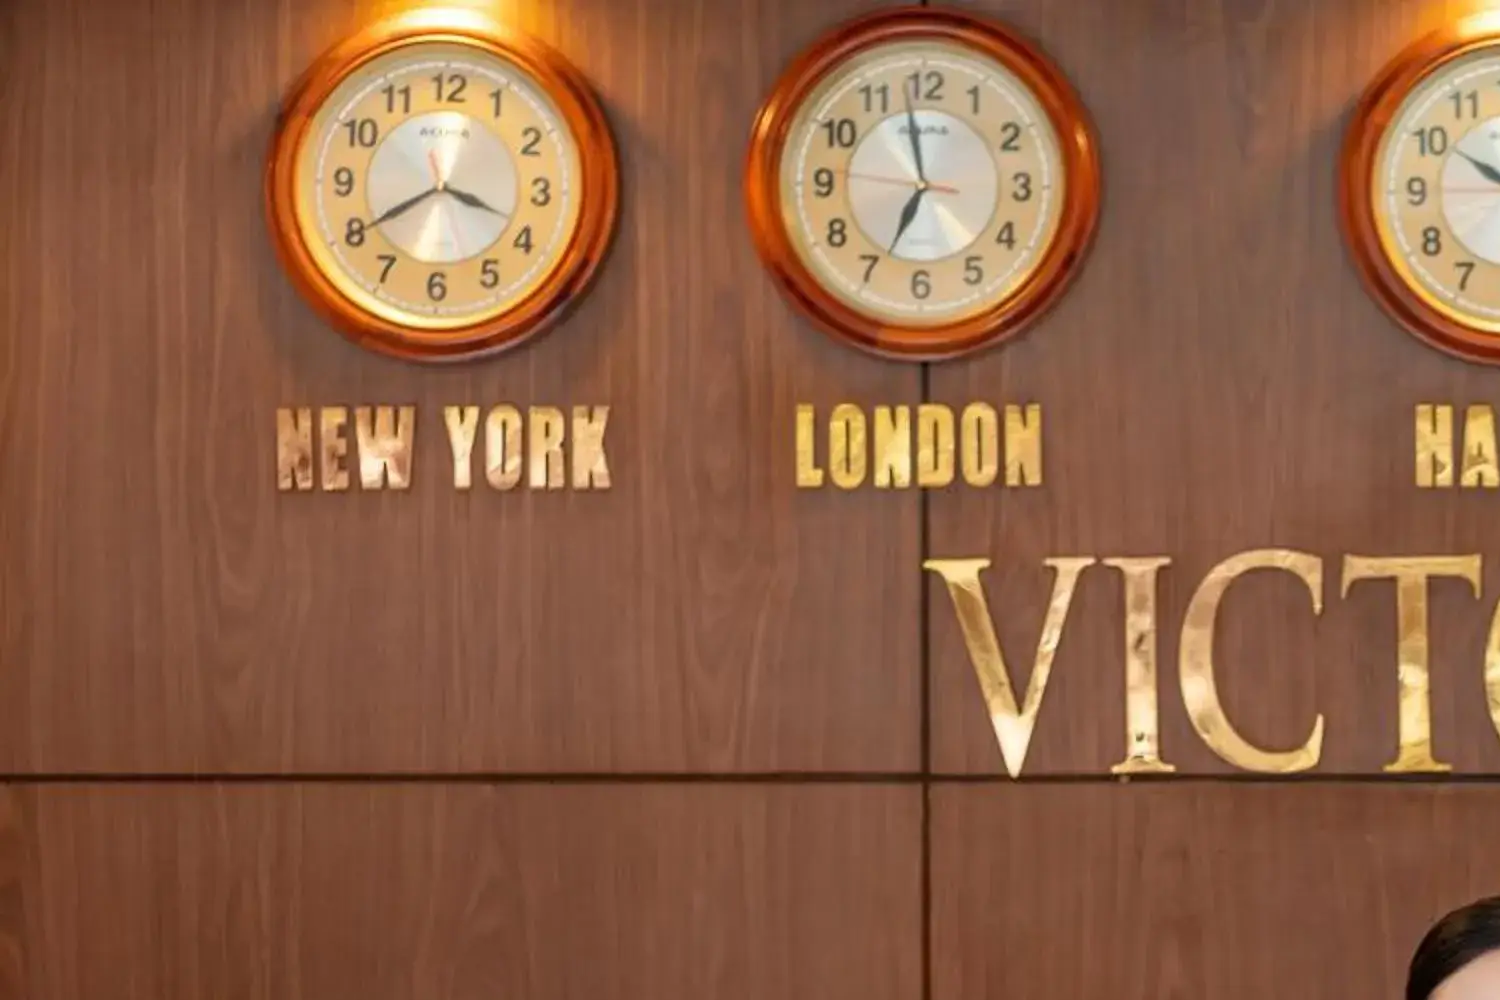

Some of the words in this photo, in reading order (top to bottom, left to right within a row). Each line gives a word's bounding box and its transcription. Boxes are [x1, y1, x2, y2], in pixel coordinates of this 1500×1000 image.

[382, 84, 411, 113] 11
[431, 73, 467, 103] 12
[858, 85, 888, 113] 11
[907, 71, 944, 100] 12
[967, 86, 979, 114] 1
[490, 89, 502, 117] 1
[1449, 90, 1478, 118] 11
[344, 119, 378, 148] 10
[521, 127, 541, 156] 2
[823, 119, 856, 148] 10
[1000, 123, 1021, 151] 2
[1414, 126, 1447, 156] 10
[334, 167, 354, 197] 9
[530, 178, 551, 207] 3
[814, 168, 834, 197] 9
[1012, 173, 1032, 201] 3
[1407, 177, 1426, 205] 9
[345, 218, 365, 247] 8
[513, 226, 533, 254] 4
[827, 219, 846, 247] 8
[996, 221, 1016, 249] 4
[1422, 227, 1441, 256] 8
[377, 255, 397, 283] 7
[480, 259, 499, 288] 5
[859, 255, 879, 282] 7
[963, 257, 983, 284] 5
[1455, 262, 1475, 290] 7
[427, 273, 446, 300] 6
[911, 270, 930, 299] 6
[277, 406, 413, 491] NEW
[444, 405, 612, 490] YORK
[794, 402, 1043, 489] LONDON
